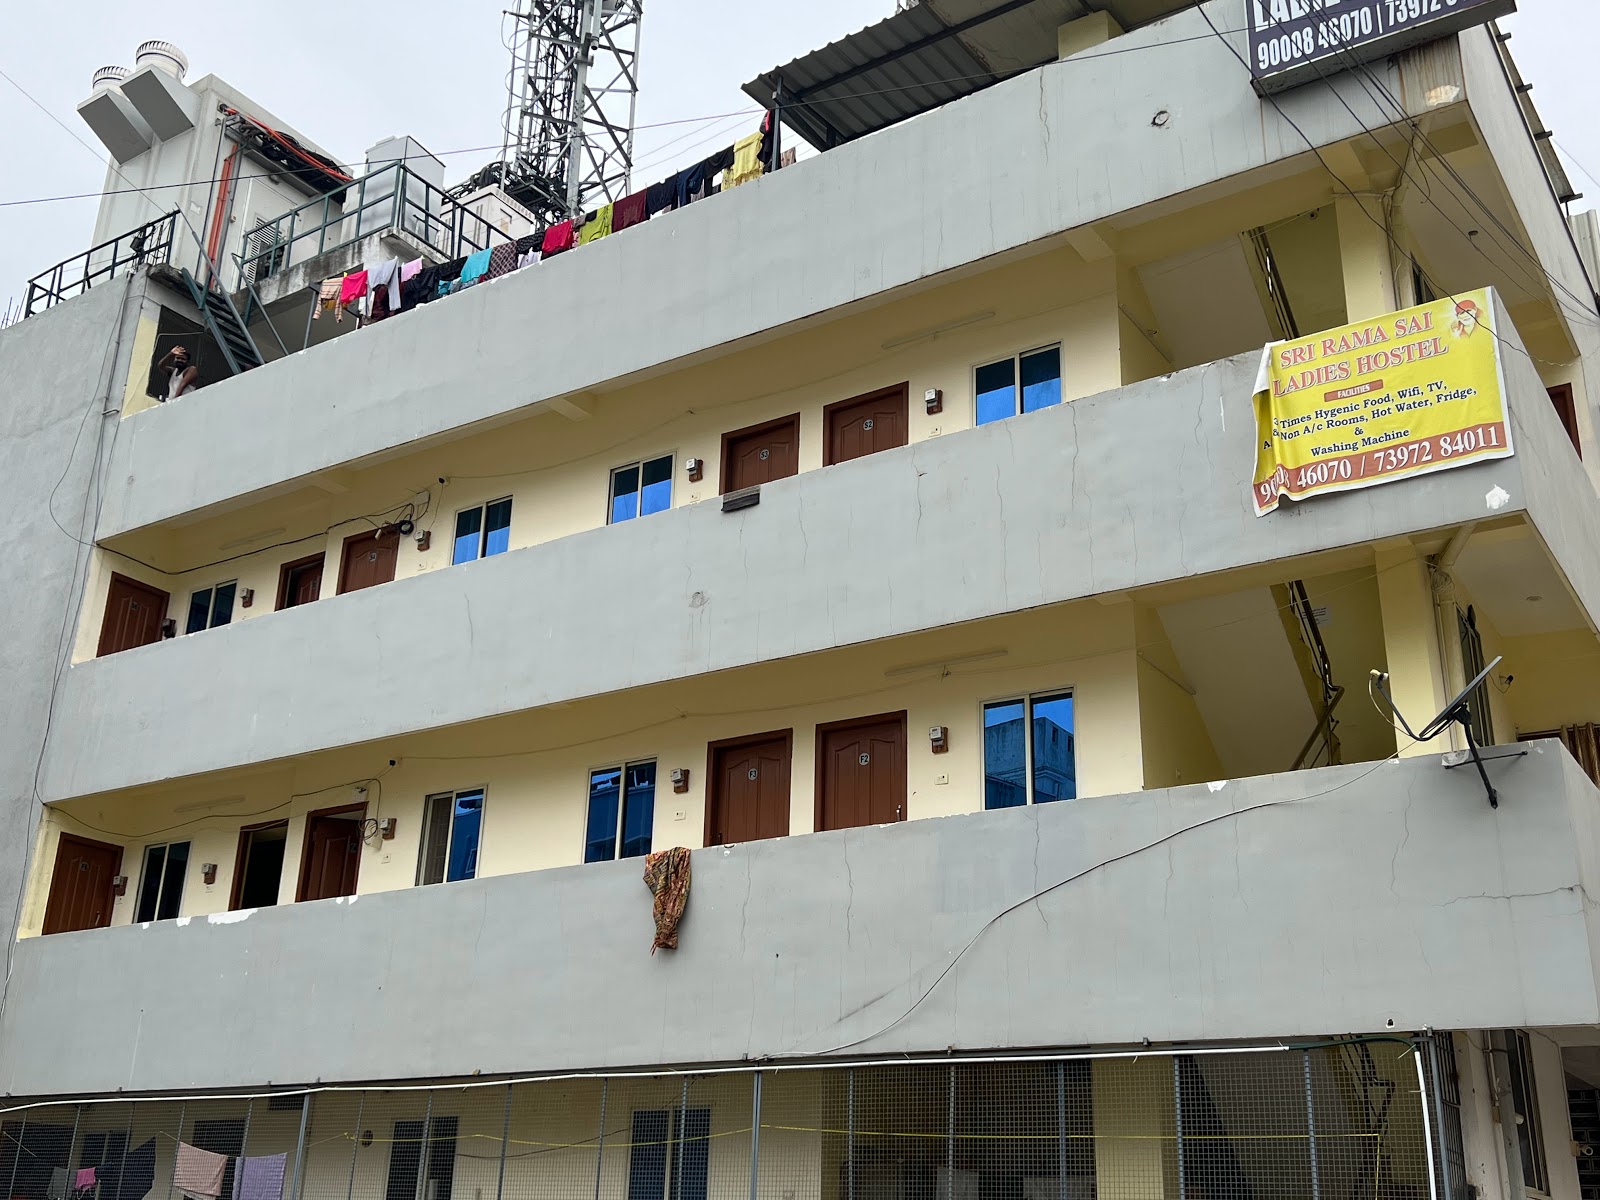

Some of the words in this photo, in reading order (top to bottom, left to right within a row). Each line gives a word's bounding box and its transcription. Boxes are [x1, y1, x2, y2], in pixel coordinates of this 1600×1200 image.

[1257, 27, 1315, 70] 90008
[1318, 6, 1373, 49] 46070
[1272, 361, 1351, 397] LADIES
[1356, 337, 1449, 376] HOSTEL
[1280, 343, 1316, 369] SRI
[1321, 325, 1390, 358] RAMA
[1394, 311, 1434, 339] SAI
[1280, 414, 1312, 429] Times
[1315, 402, 1360, 420] Hygenic
[1363, 394, 1395, 409] Food,
[1397, 386, 1424, 400] Wifi,
[1427, 380, 1448, 393] TV,
[1280, 429, 1301, 441] Non
[1303, 423, 1323, 435] A/c
[1326, 415, 1369, 429] Rooms,
[1371, 407, 1392, 420] Hot
[1395, 398, 1433, 413] Water,
[1436, 386, 1477, 404] Fridge,
[1337, 384, 1370, 399] FACILITIES
[1297, 459, 1352, 488] 46070
[1373, 441, 1433, 472] 73972
[1440, 426, 1500, 457] 84011
[1311, 440, 1359, 457] Washing
[1361, 428, 1410, 447] Machine
[1354, 427, 1364, 436] &
